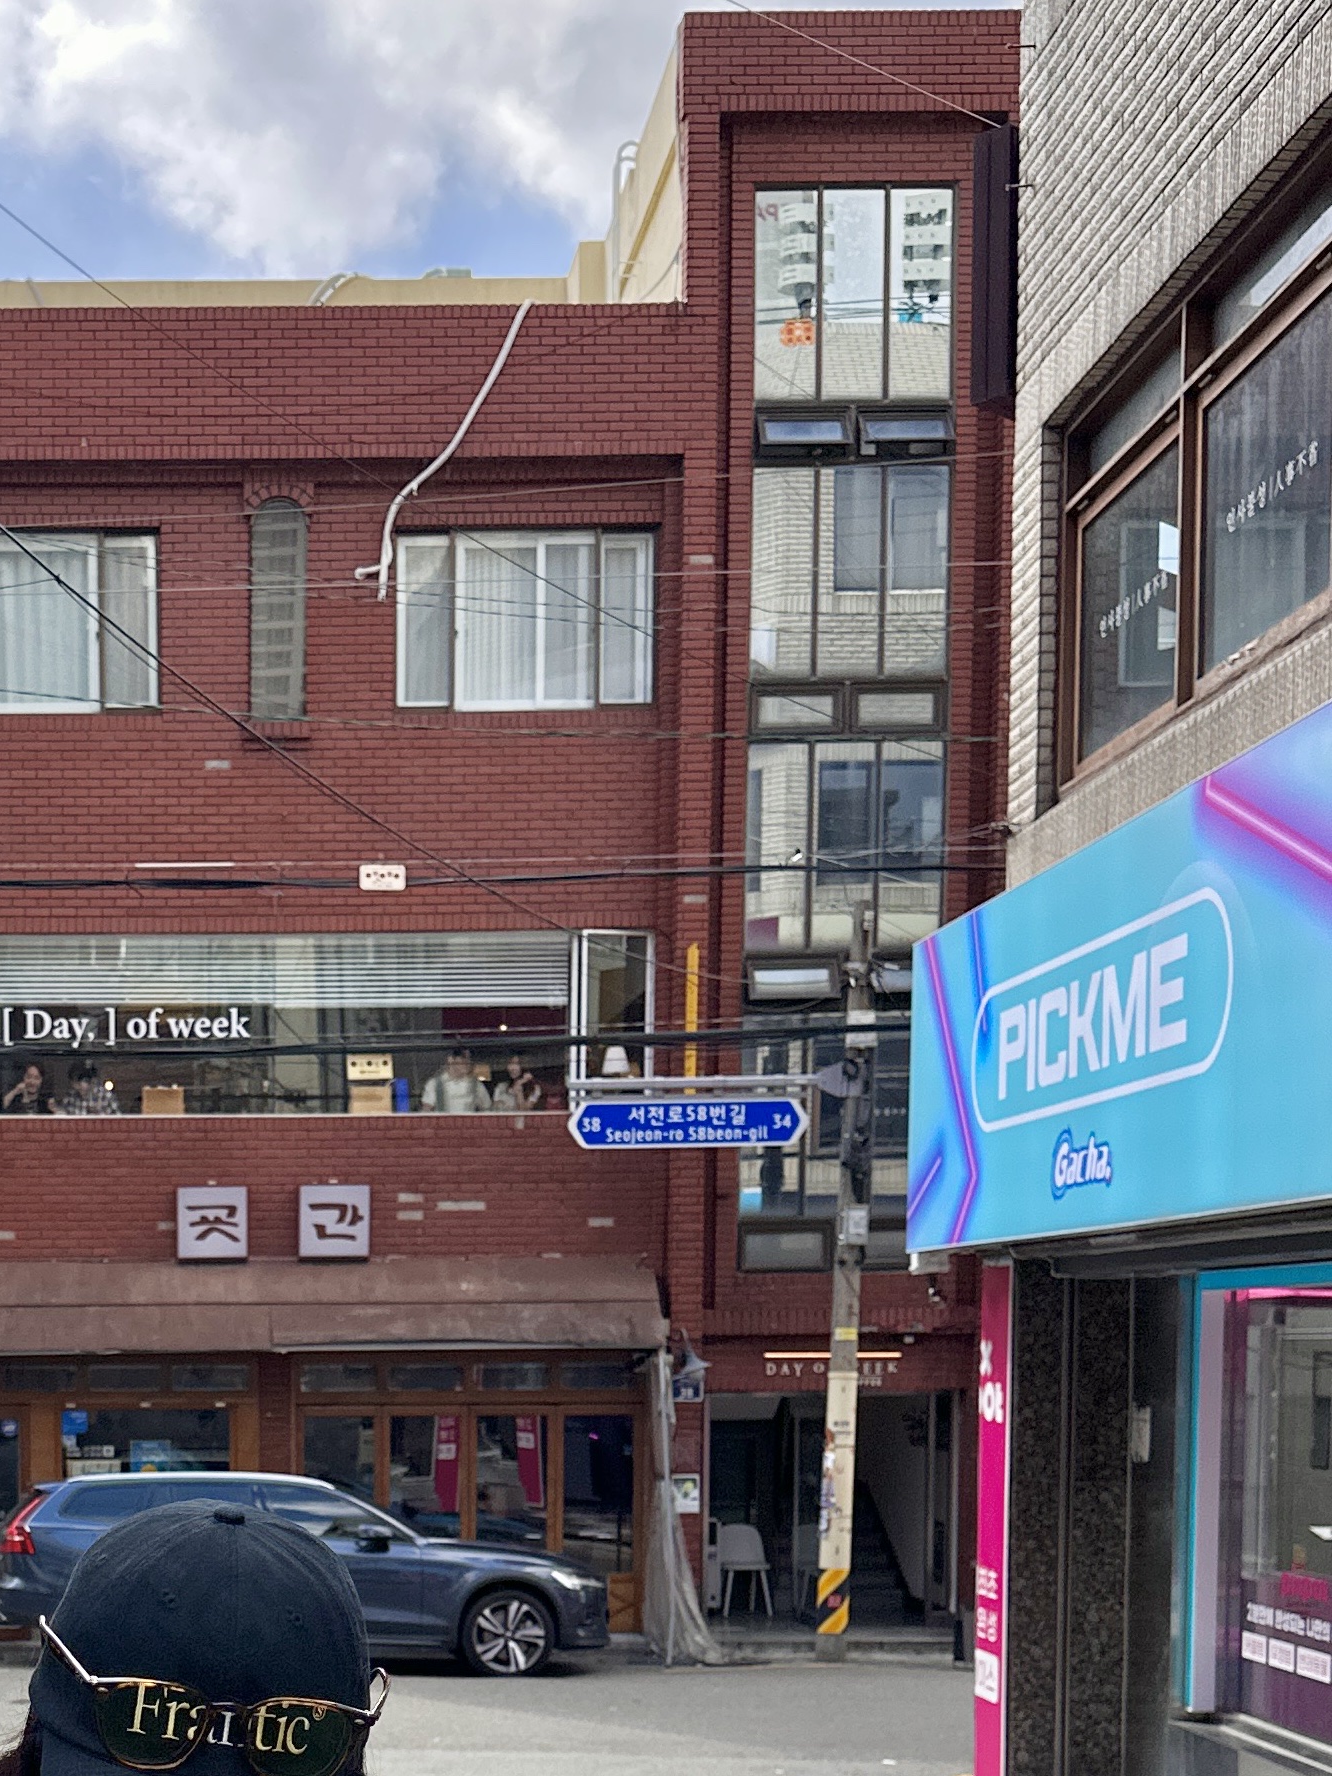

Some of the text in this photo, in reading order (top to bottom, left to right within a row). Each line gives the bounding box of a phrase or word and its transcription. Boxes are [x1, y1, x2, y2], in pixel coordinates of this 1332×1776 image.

[126, 1008, 164, 1039] of
[167, 1008, 251, 1039] week
[998, 932, 1188, 1101] PICKME
[581, 1104, 792, 1133] 38 서전로58번길 34
[765, 1362, 804, 1377] DAY
[858, 1361, 899, 1376] EEK
